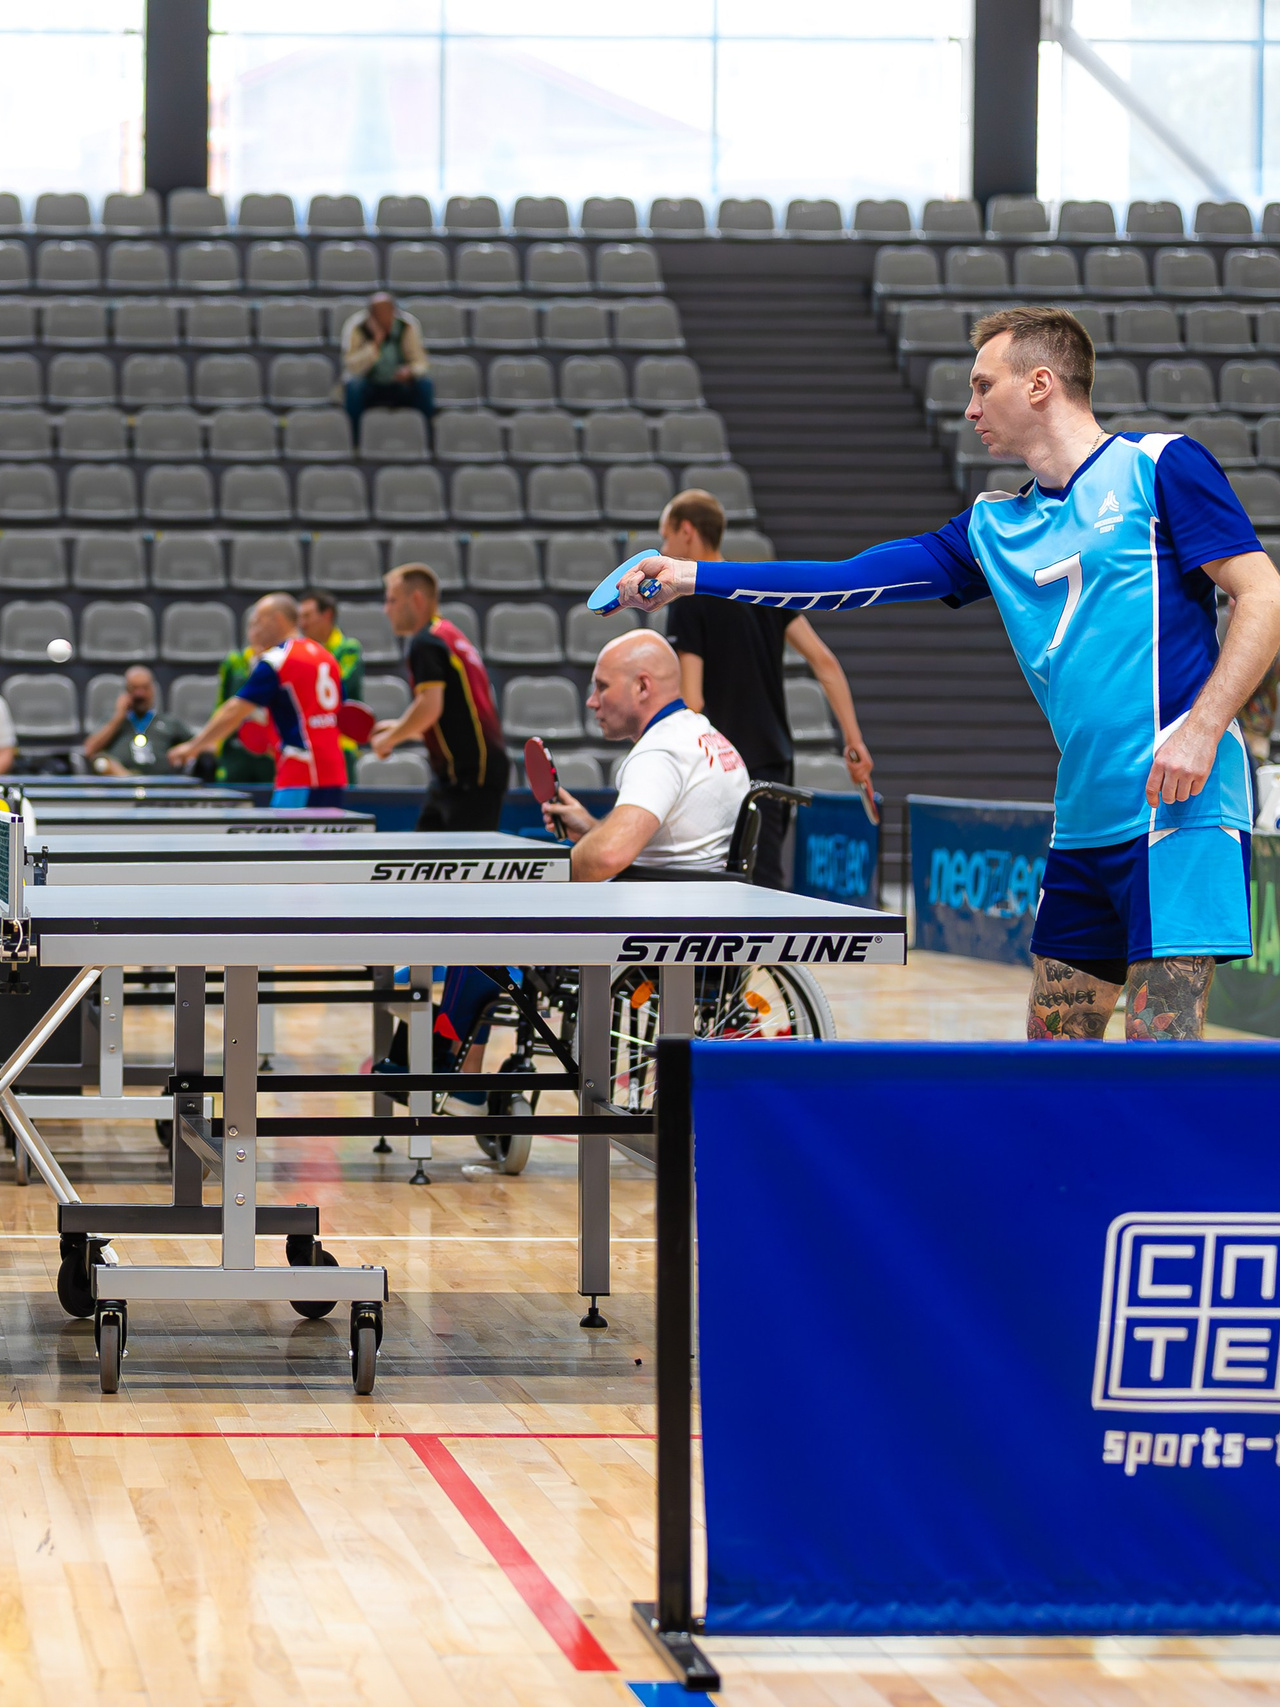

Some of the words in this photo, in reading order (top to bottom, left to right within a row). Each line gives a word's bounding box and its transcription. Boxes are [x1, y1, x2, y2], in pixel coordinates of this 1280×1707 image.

[1034, 551, 1083, 650] 7
[316, 662, 339, 711] 6
[370, 862, 479, 881] START
[616, 935, 775, 962] START
[1103, 1427, 1280, 1476] sports-
